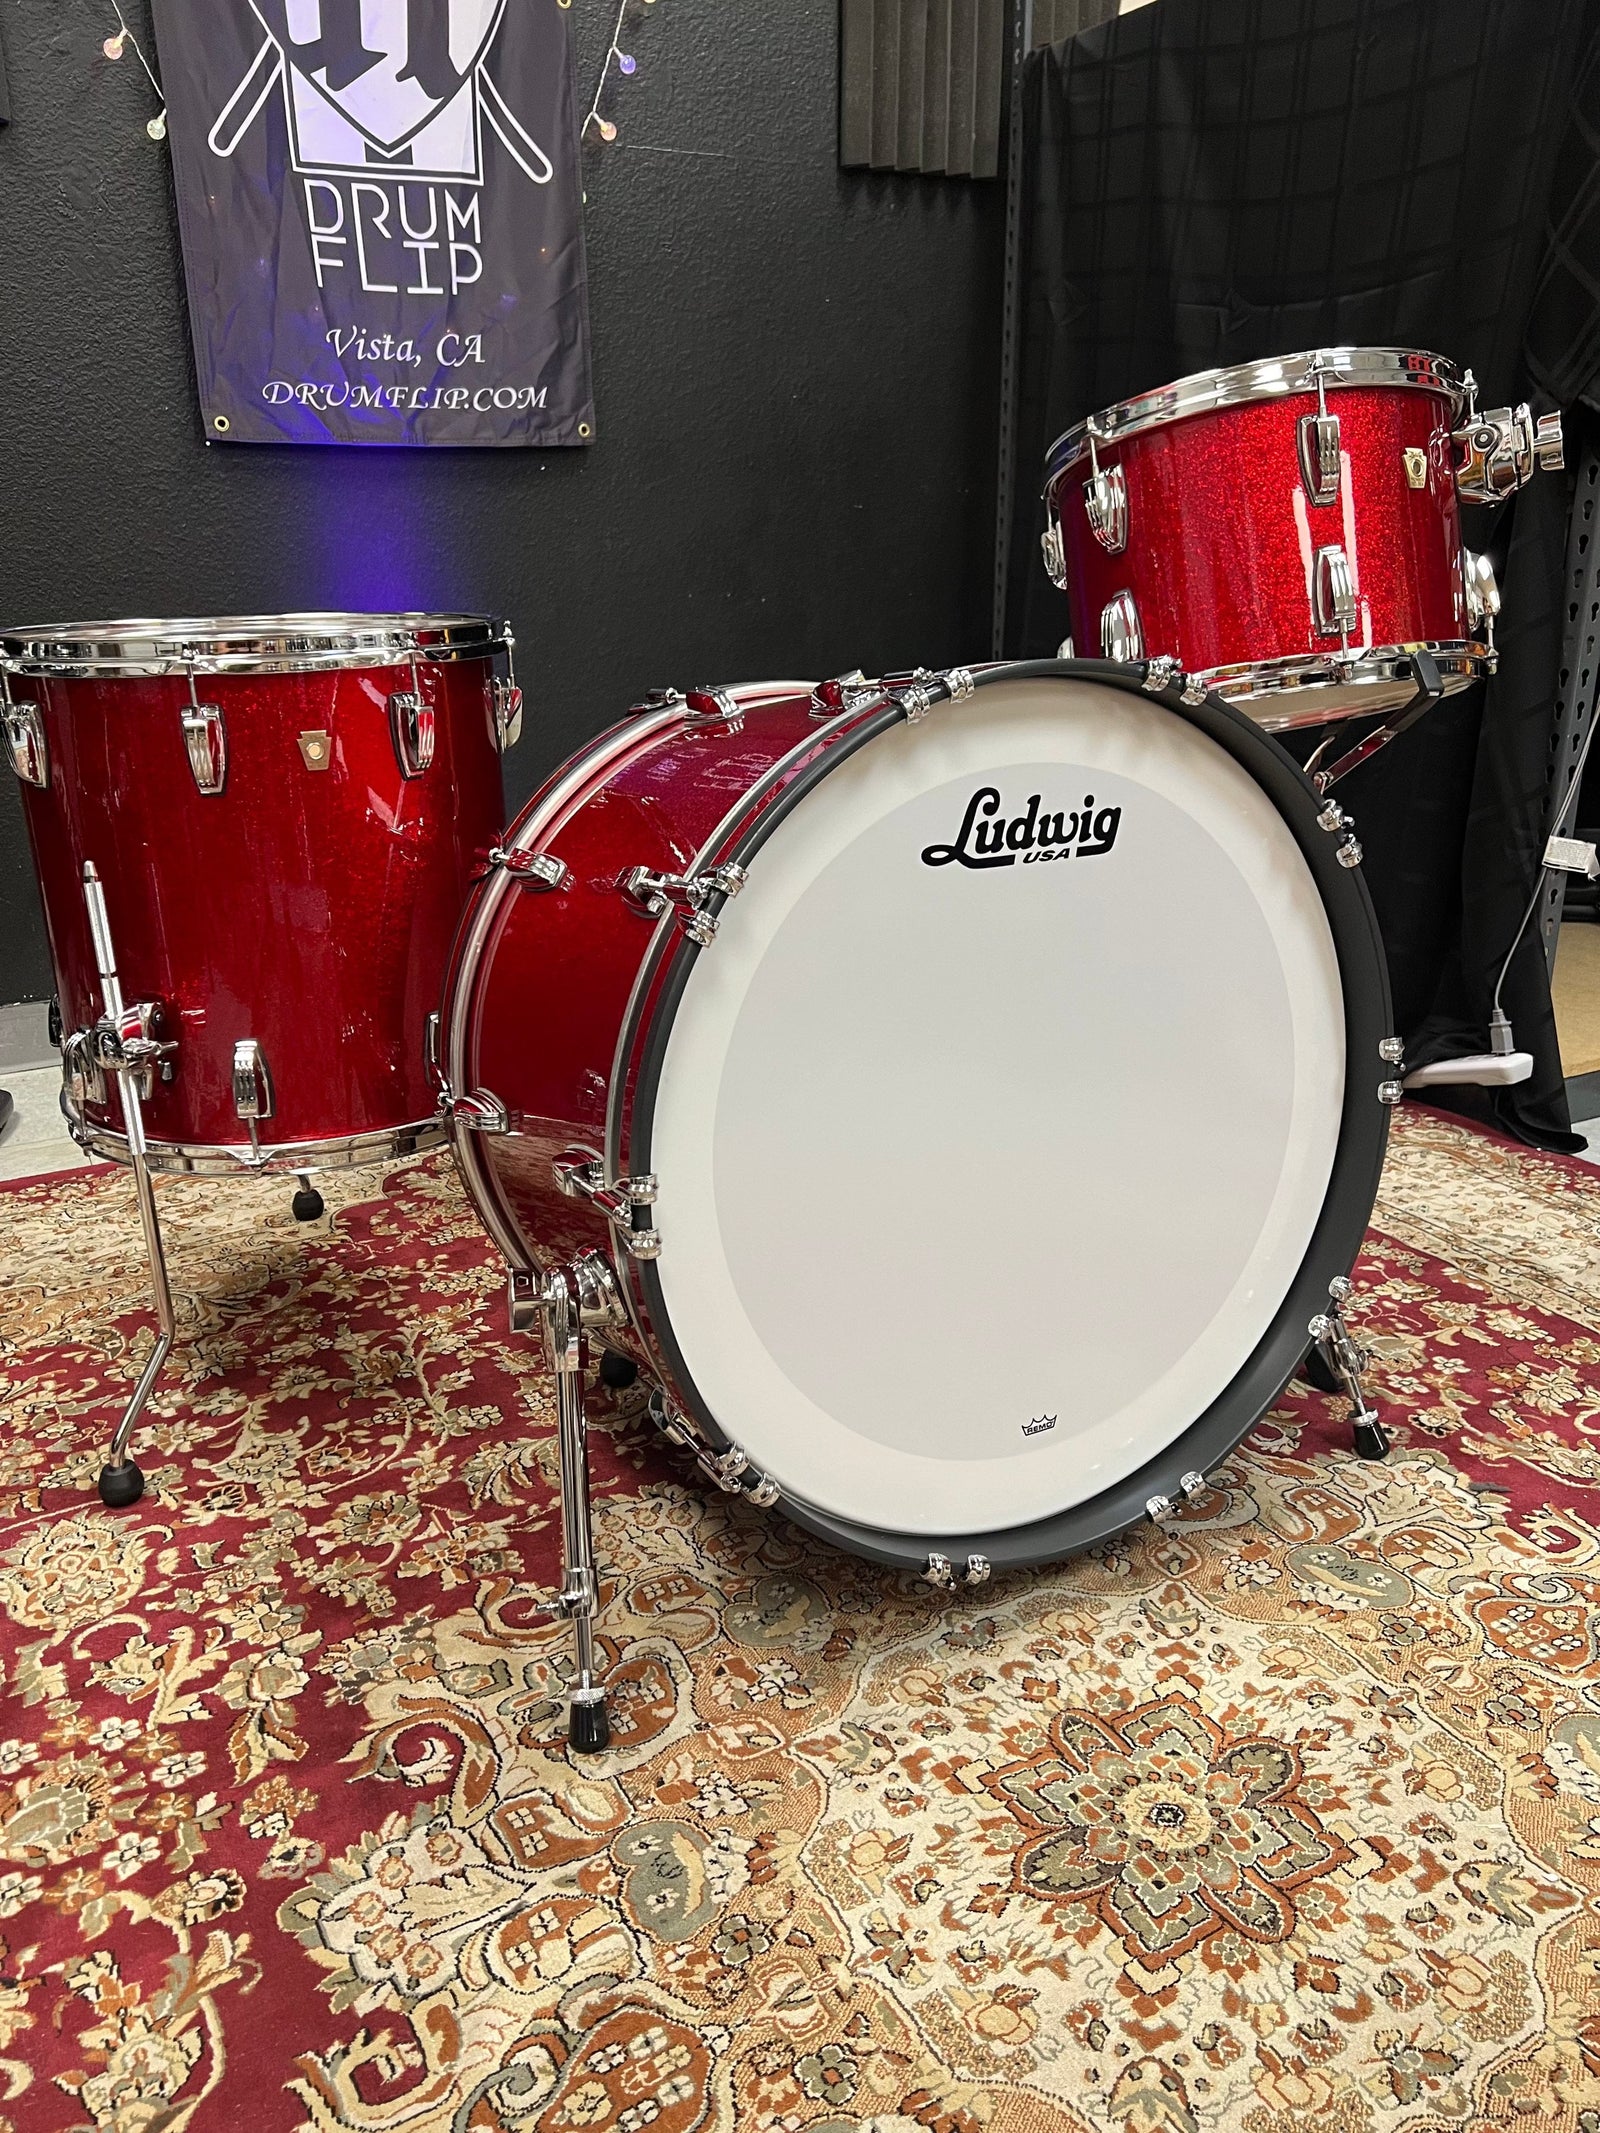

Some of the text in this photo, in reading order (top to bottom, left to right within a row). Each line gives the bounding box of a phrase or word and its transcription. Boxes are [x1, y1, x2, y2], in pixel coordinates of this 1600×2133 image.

[303, 178, 482, 244] DRUM
[311, 233, 484, 296] FLIP
[325, 325, 486, 368] Vista, CA
[261, 381, 549, 412] DRUMFLIP.COM
[920, 786, 1122, 870] Ludwig
[1022, 848, 1070, 864] USA
[1026, 1421, 1053, 1434] REMO
